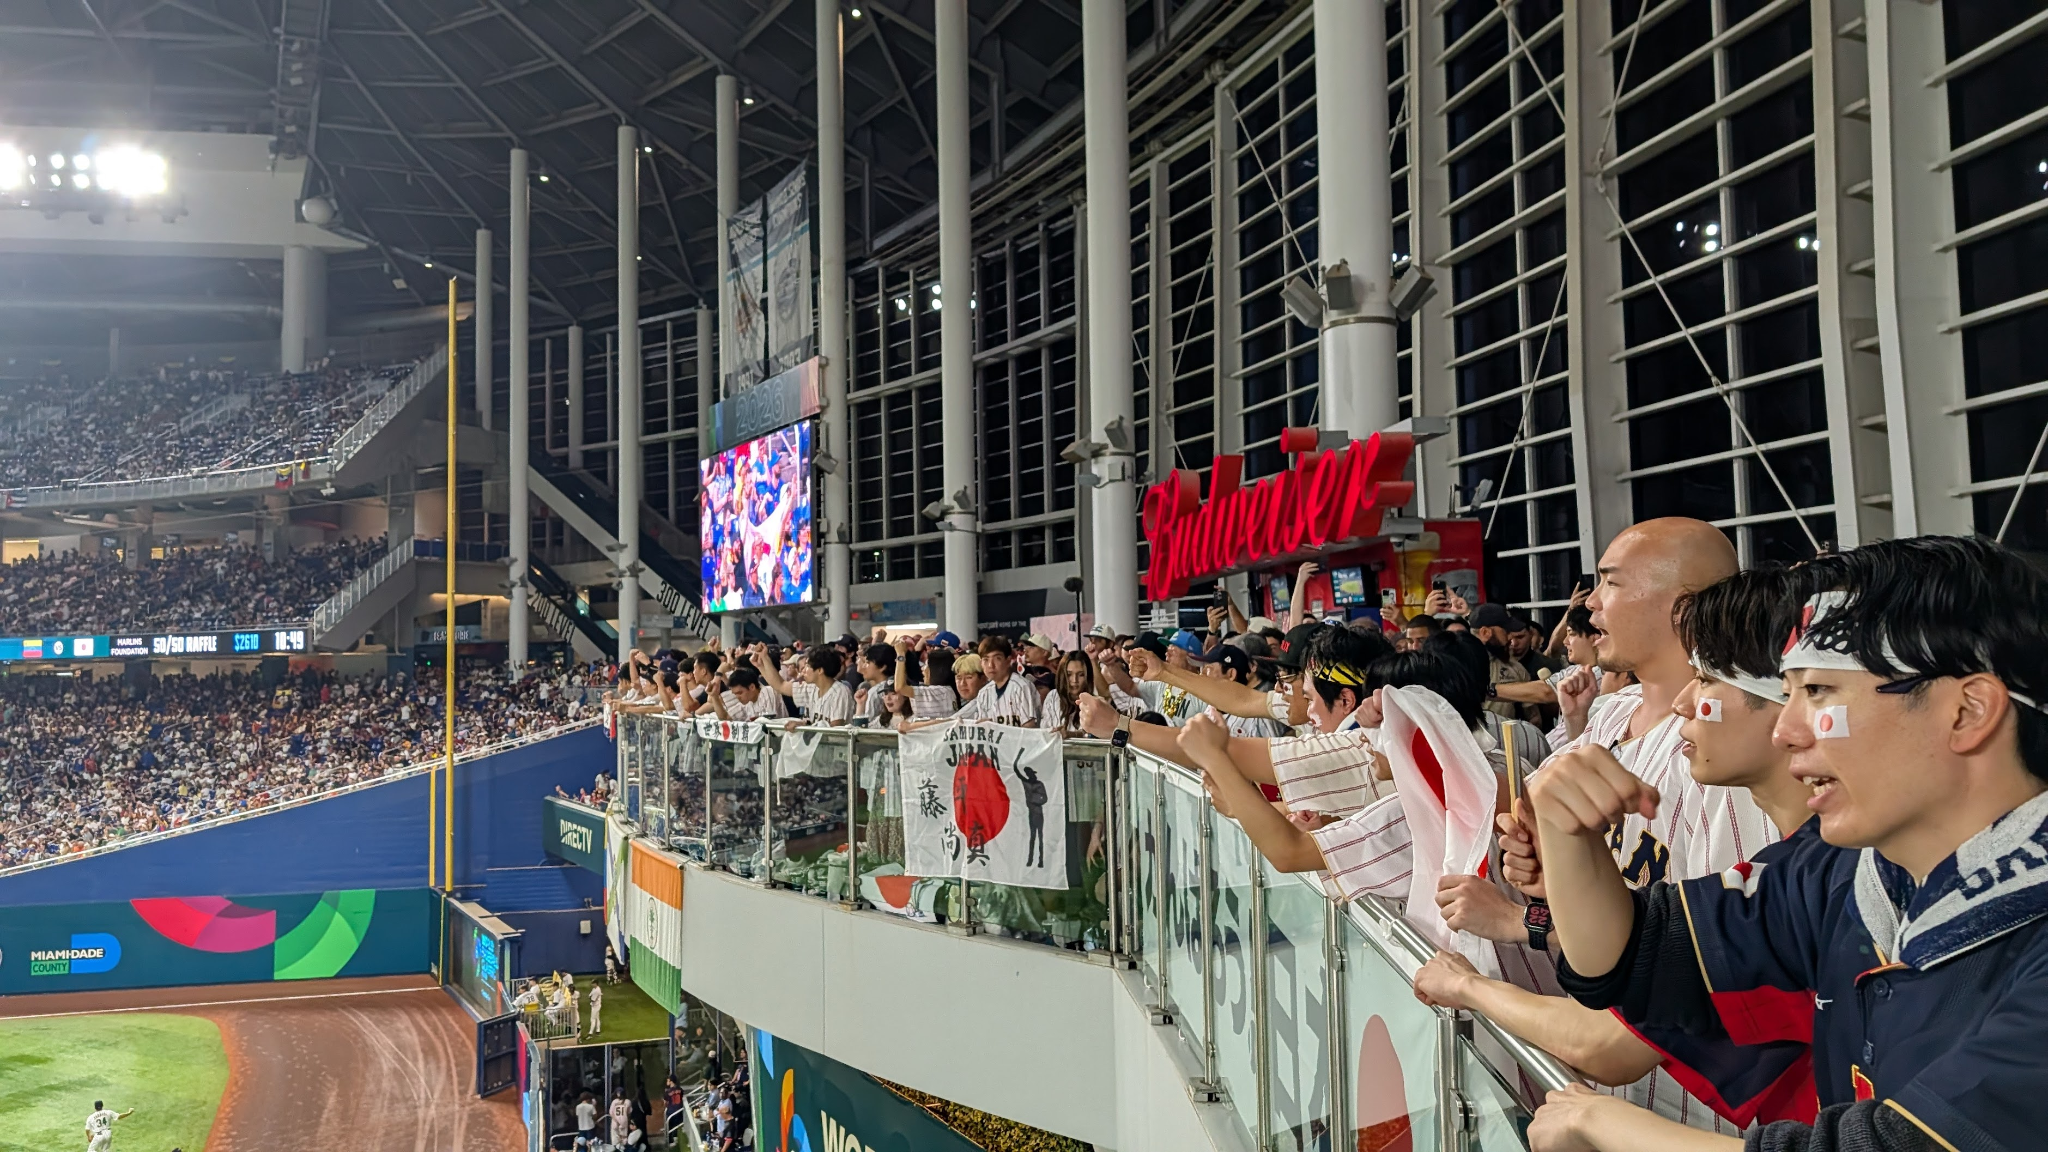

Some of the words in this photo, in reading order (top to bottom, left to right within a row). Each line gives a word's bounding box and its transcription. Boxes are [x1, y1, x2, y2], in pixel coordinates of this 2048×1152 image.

[736, 379, 784, 437] 2026
[1143, 427, 1382, 601] Budweiser
[656, 580, 680, 614] 300
[681, 599, 711, 641] LEVEL
[117, 638, 142, 646] MARLINS
[153, 635, 184, 655] 50/50
[186, 636, 217, 652] RAFFLE
[235, 633, 259, 652] $2610
[275, 631, 304, 650] 10:49
[110, 647, 148, 656] FOUNDATION
[943, 725, 1004, 744] SAMURAI
[946, 743, 1000, 771] JAPAN
[560, 818, 592, 854] DIRECTV
[31, 948, 103, 961] MIAMI-DADE
[32, 962, 67, 973] COUNTY
[615, 1106, 624, 1116] 51
[96, 1118, 107, 1128] 34
